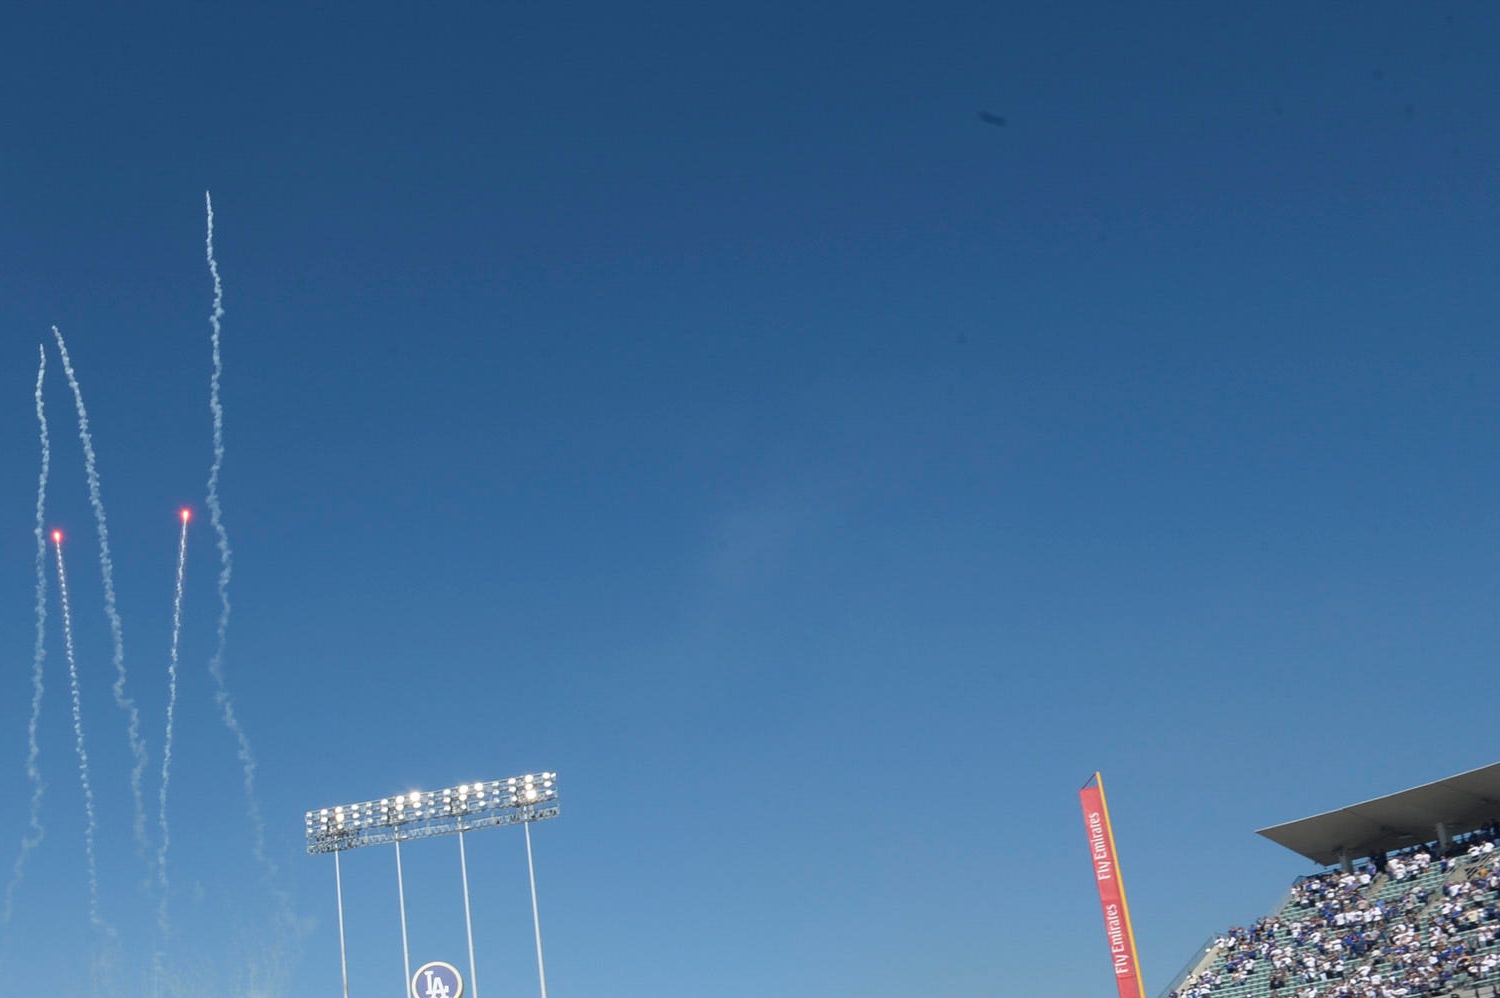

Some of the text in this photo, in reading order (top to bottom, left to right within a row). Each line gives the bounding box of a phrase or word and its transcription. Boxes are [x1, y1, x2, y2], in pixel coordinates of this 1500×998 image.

[1088, 812, 1112, 880] Fly Emirates
[1106, 903, 1129, 974] Fly Emirates
